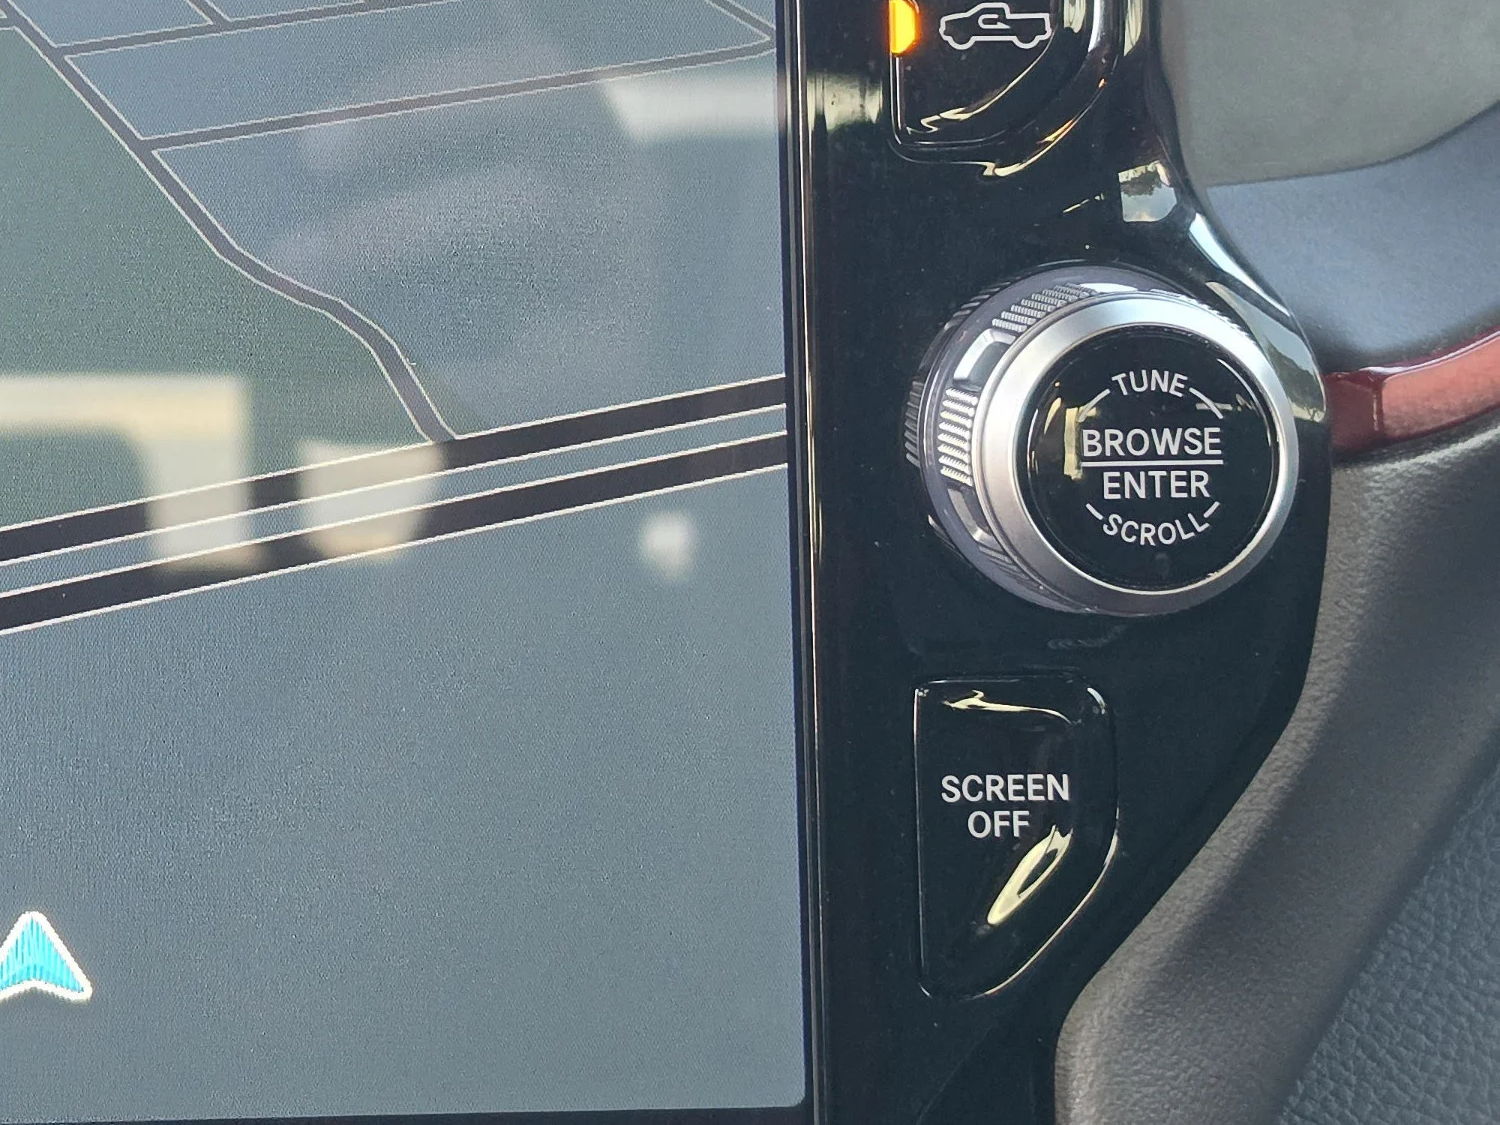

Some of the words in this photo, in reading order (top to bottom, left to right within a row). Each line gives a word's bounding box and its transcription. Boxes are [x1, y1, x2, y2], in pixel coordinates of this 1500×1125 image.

[1111, 370, 1188, 399] TUNE
[1081, 427, 1222, 458] BROWSE
[1102, 470, 1211, 500] ENTER
[1101, 513, 1210, 547] SCROLL
[941, 773, 1070, 802] SCREEN
[967, 810, 1030, 838] OFF
